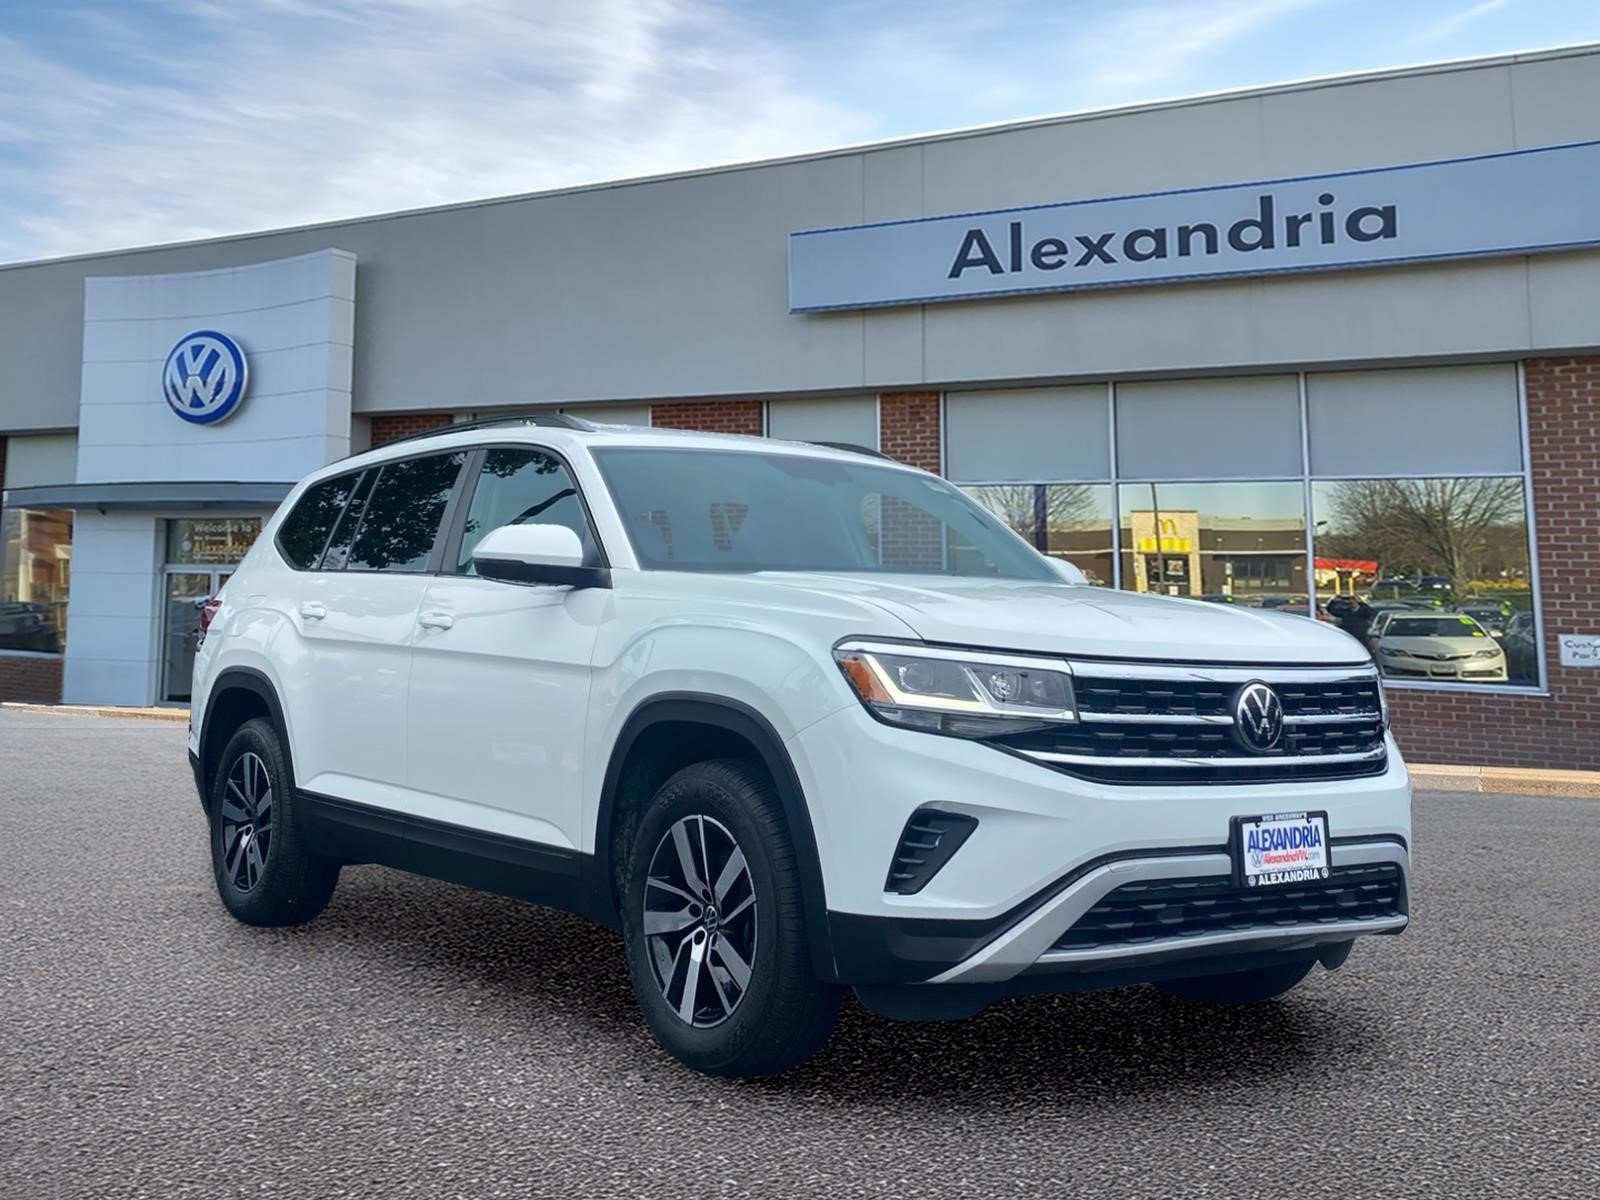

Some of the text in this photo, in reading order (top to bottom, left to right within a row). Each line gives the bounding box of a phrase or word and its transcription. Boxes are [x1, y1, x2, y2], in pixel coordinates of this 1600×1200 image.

[947, 192, 1398, 279] Alexandria
[166, 337, 236, 416] VW
[1247, 825, 1321, 852] ALEXANDRIA
[1258, 868, 1320, 885] ALEXANDRIA
